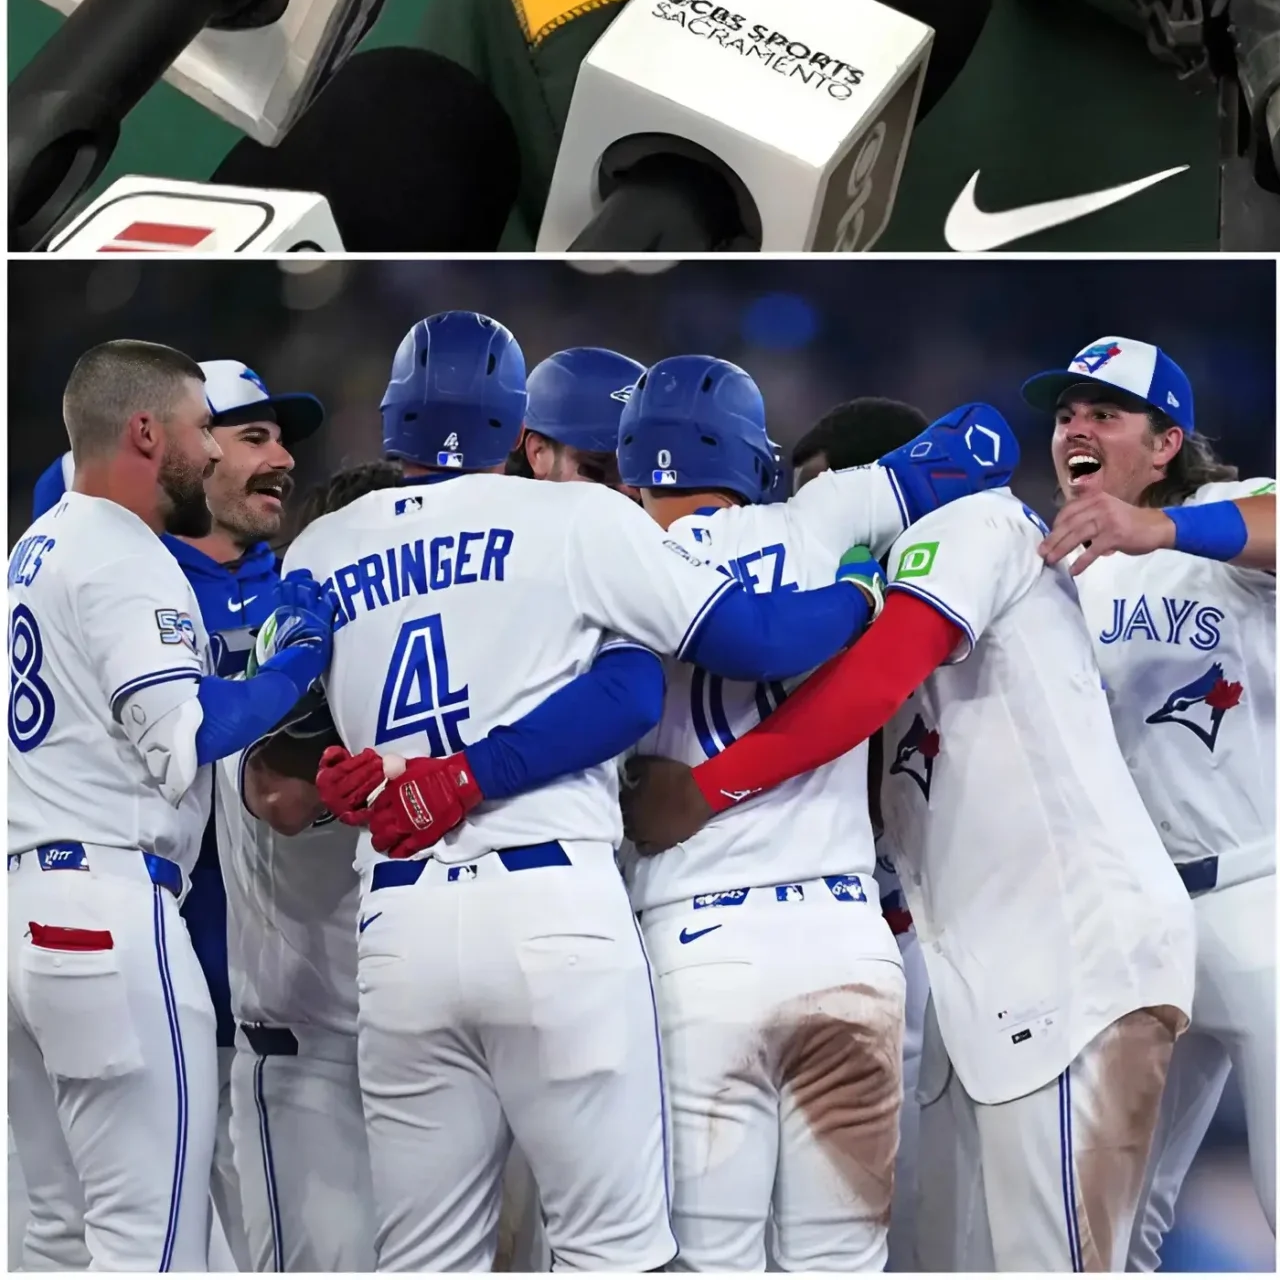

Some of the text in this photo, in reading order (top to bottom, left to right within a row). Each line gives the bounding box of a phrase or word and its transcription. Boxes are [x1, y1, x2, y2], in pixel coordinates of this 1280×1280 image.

[651, 1, 853, 101] SACRAMENTO
[747, 24, 865, 85] SPORTS
[1099, 593, 1226, 651] JAYS
[374, 612, 471, 758] 4
